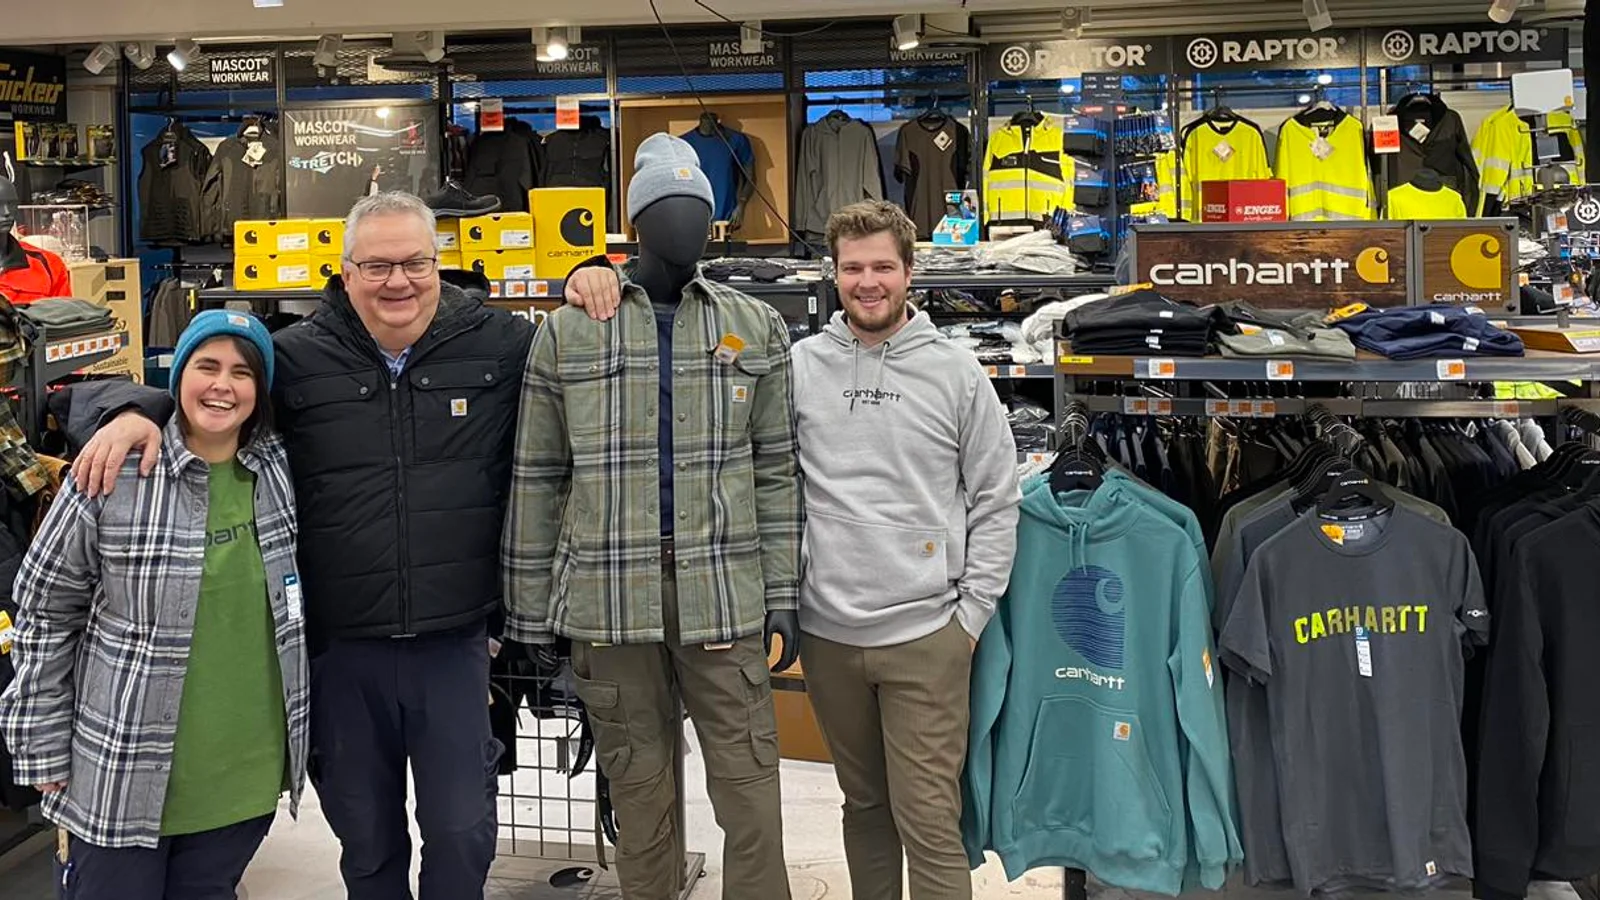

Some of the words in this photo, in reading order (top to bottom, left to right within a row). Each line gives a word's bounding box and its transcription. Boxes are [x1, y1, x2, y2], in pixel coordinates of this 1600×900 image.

[709, 41, 767, 55] MAST
[1419, 30, 1541, 55] RAPTOR
[1223, 37, 1339, 63] RAPTOR
[211, 58, 261, 72] MASCOT
[709, 55, 774, 68] WORKWEAR
[1035, 45, 1146, 71] RTOR
[537, 62, 600, 73] WORKWEAR
[211, 71, 269, 83] WORKWEAR
[294, 120, 349, 134] MASCOT
[294, 134, 356, 146] WORKWEAR
[292, 151, 358, 168] STRETCH
[1243, 205, 1282, 215] ENGEL
[1150, 258, 1350, 285] carhartt
[1433, 291, 1502, 301] carhartt
[1294, 604, 1429, 644] CARHARTT
[1054, 666, 1125, 690] carhartt
